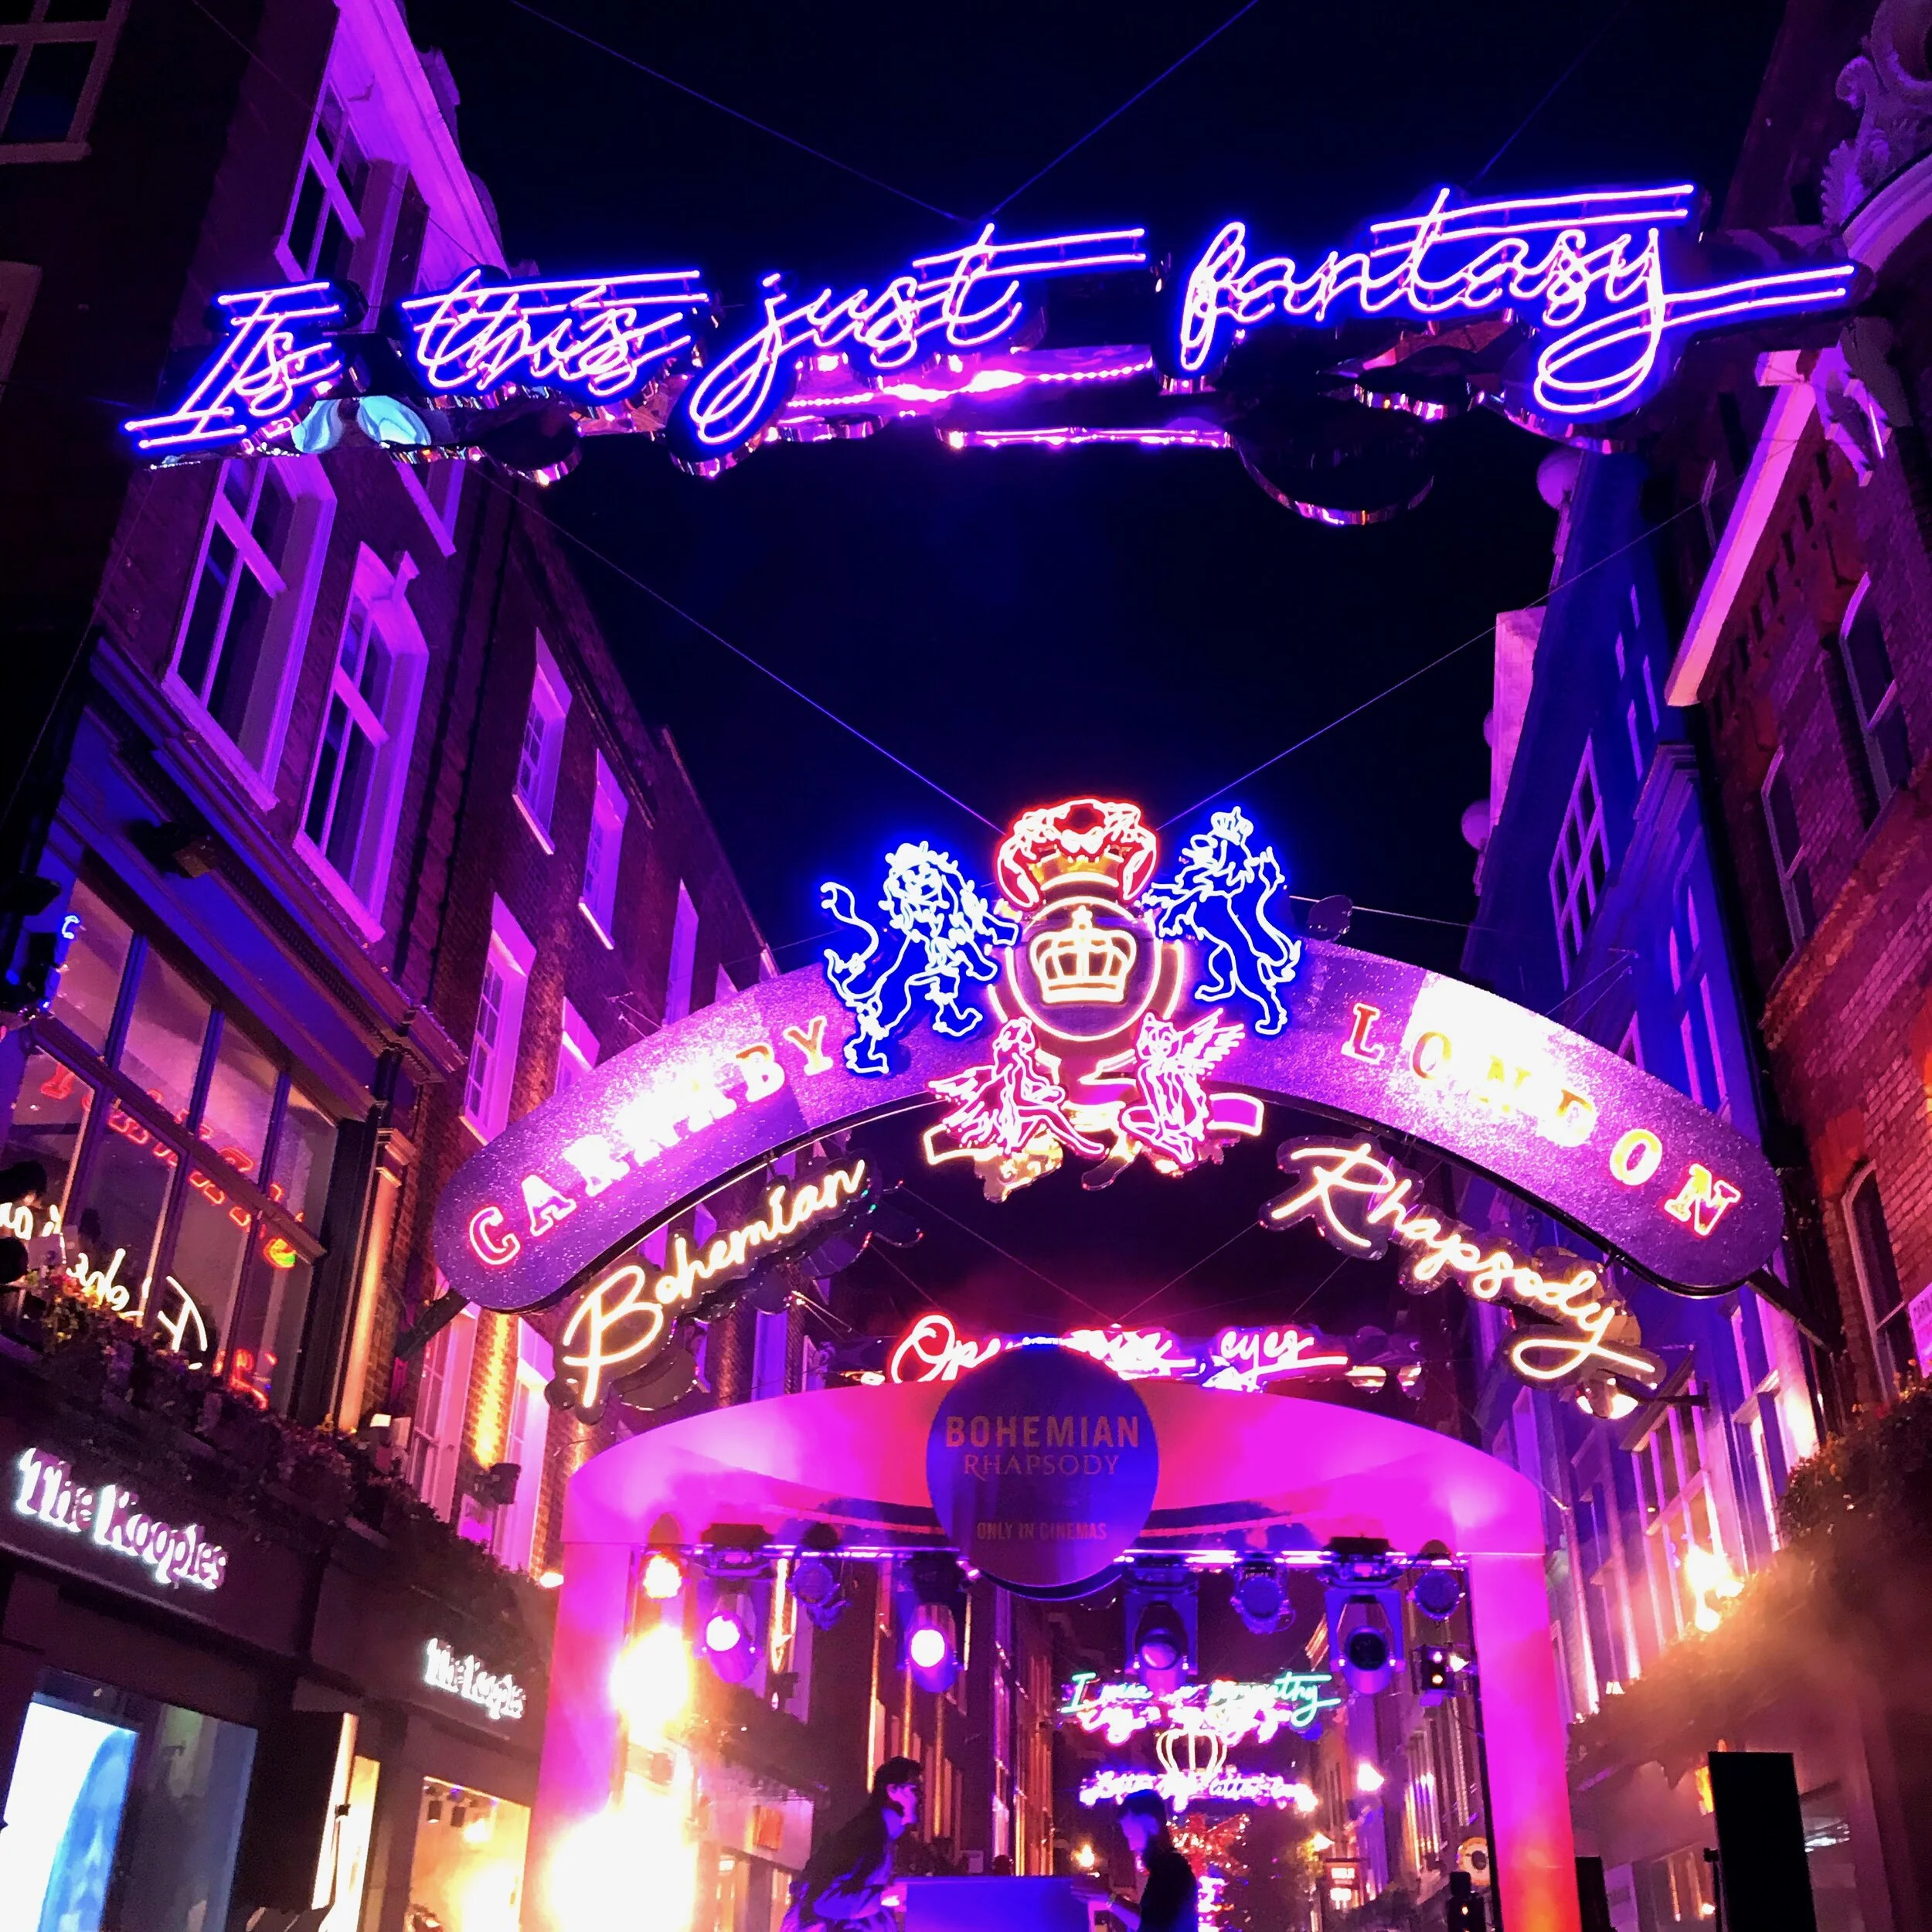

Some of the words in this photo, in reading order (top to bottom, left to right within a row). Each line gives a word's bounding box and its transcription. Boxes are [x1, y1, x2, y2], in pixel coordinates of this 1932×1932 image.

[126, 281, 341, 448] Is
[402, 269, 708, 396] this
[689, 223, 1145, 444] just
[1181, 187, 1854, 413] fantasy
[1341, 1002, 1741, 1236] LONDON
[563, 1159, 866, 1408] Bohemian
[1271, 1143, 1655, 1380] Rhapsody
[945, 1415, 1139, 1448] BOHEMIAN
[963, 1454, 1119, 1481] RHAPSODY
[976, 1522, 1014, 1540] ONLY
[1018, 1522, 1035, 1540] IN
[1039, 1522, 1107, 1540] CINEMAS
